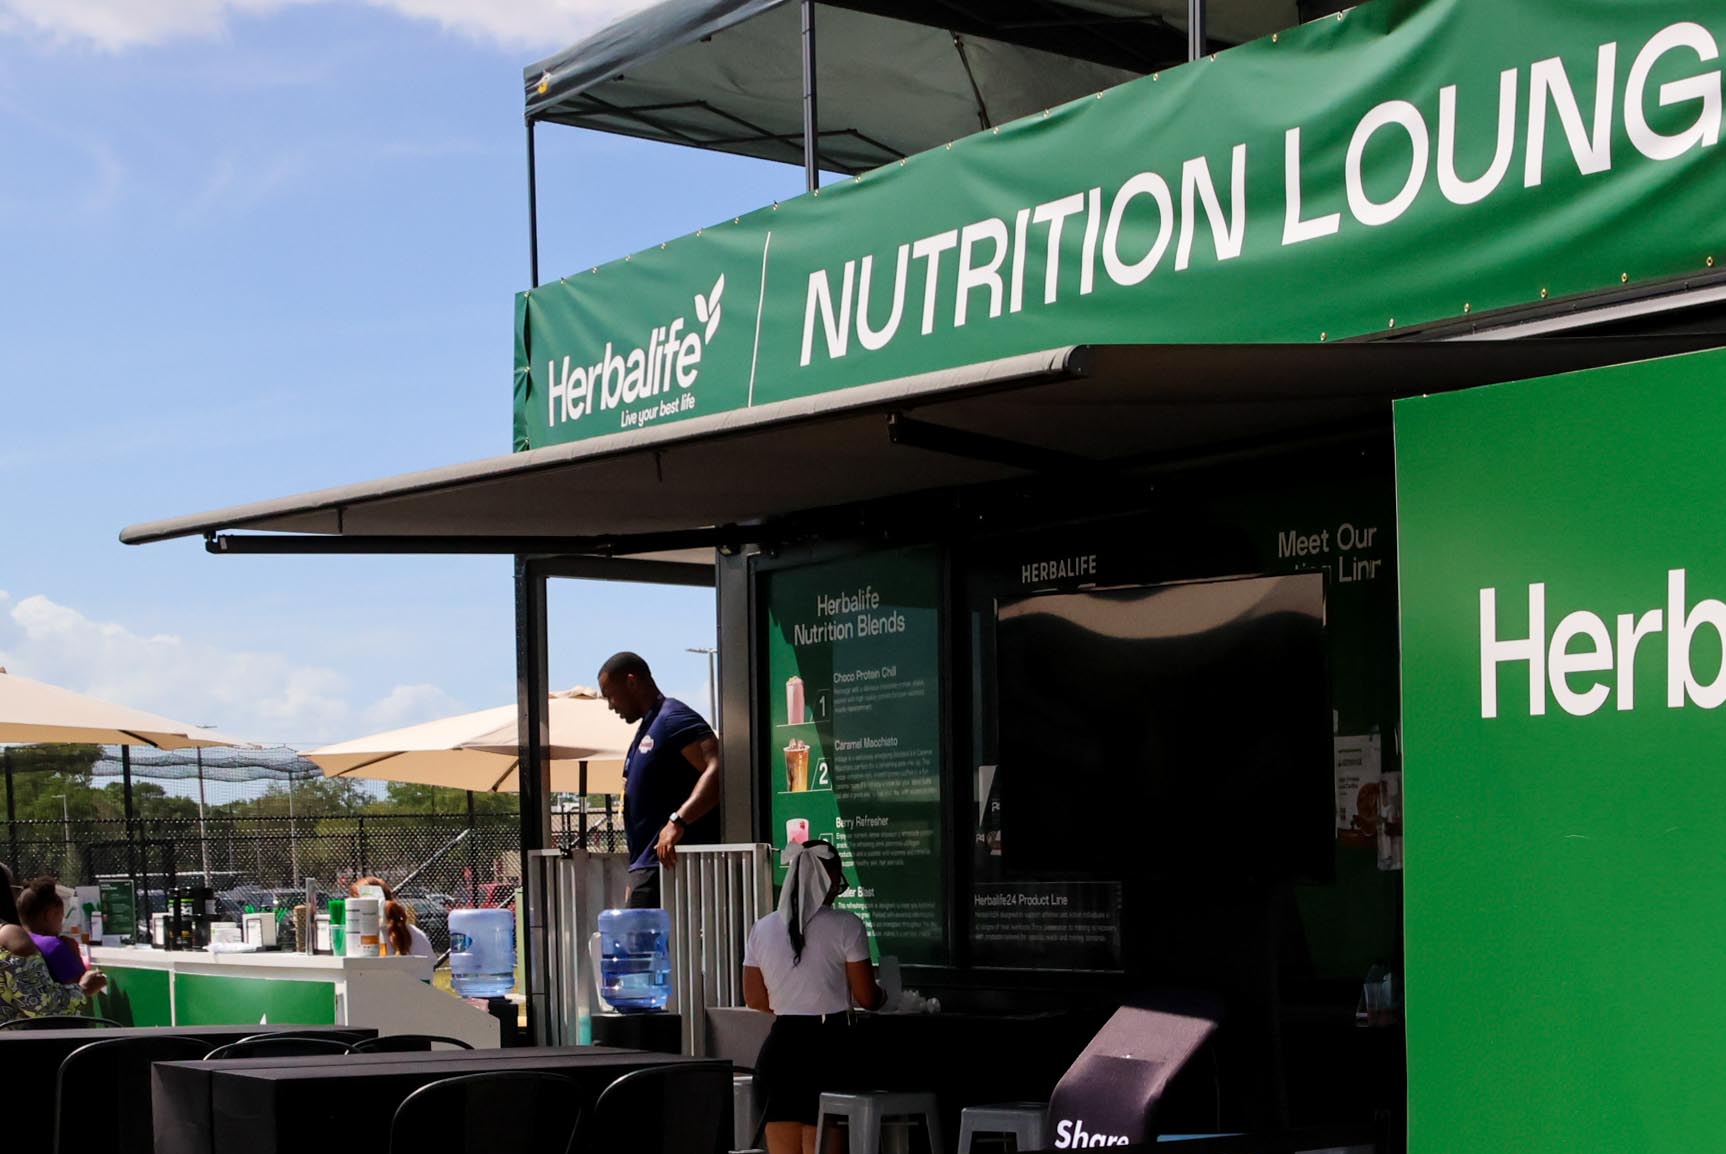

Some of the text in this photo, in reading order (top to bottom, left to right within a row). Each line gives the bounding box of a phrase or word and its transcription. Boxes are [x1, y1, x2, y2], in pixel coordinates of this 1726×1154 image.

[800, 143, 1245, 367] NUTRITION
[548, 317, 702, 427] Herbalife
[620, 393, 696, 427] Live your best life
[1278, 522, 1377, 558] Meet Our
[1022, 555, 1096, 583] HERBALIFE
[817, 585, 880, 617] Herbalife
[794, 609, 906, 646] Nutrition Blends
[819, 695, 827, 718] 1
[834, 739, 863, 752] Caramel
[818, 762, 829, 786] 2
[835, 814, 889, 830] Berry Refresher
[1018, 892, 1050, 907] Product
